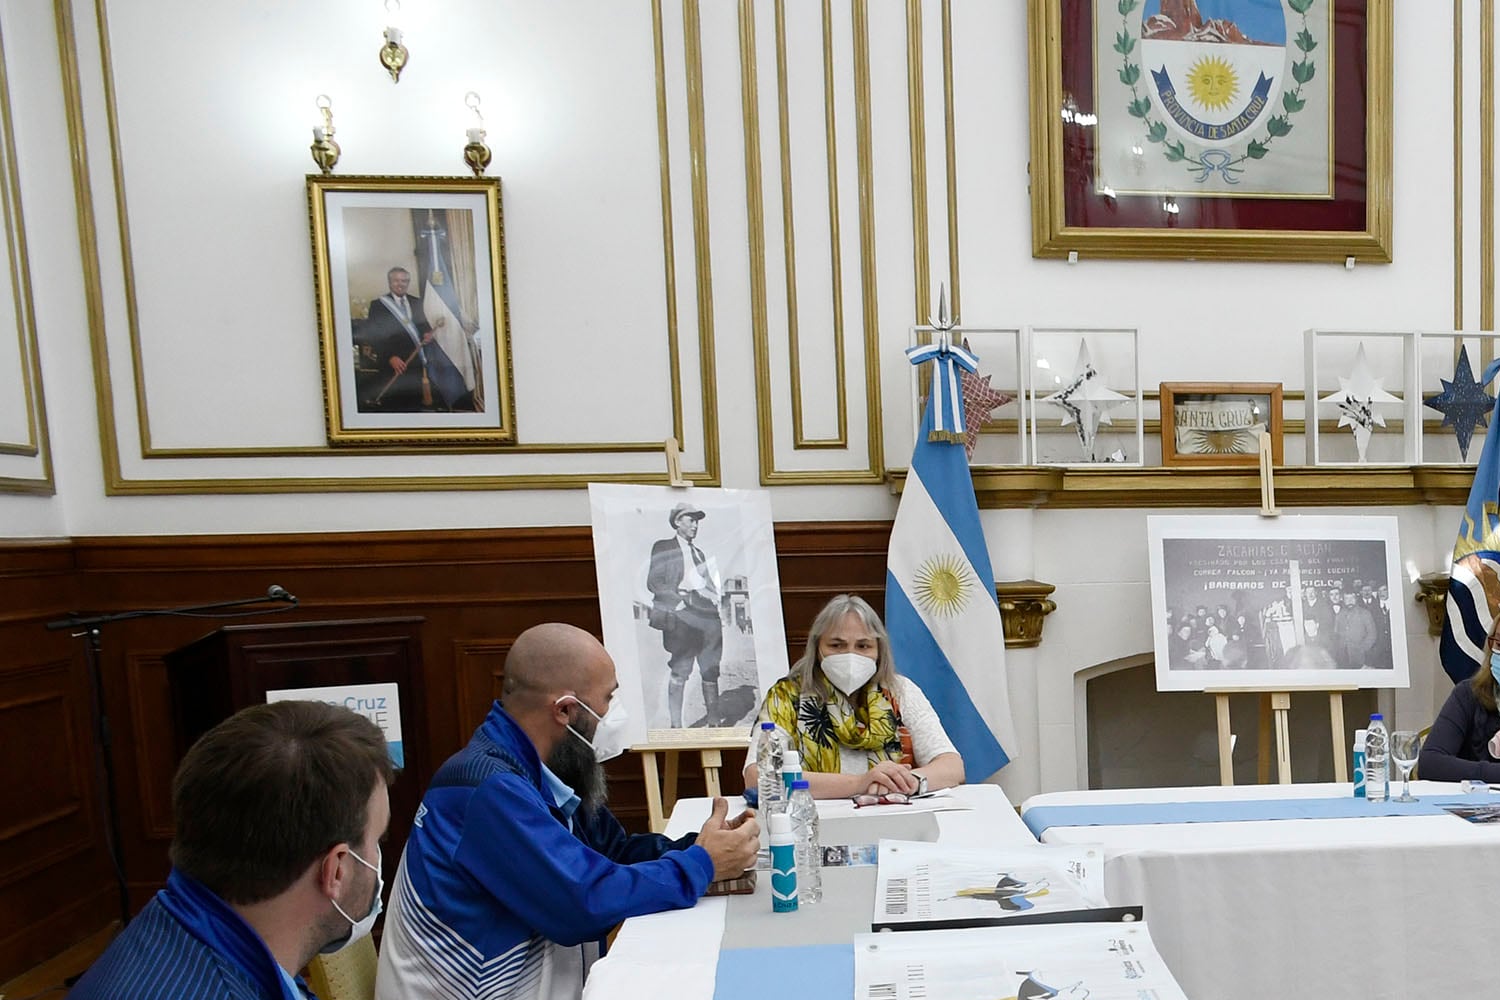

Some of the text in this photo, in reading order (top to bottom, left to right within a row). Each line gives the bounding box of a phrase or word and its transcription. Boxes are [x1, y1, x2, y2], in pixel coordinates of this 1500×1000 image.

[1162, 90, 1265, 139] PROVINCIA DE SANTA CRUZ
[1175, 408, 1252, 428] SANTA CRUZ
[1217, 544, 1275, 558] ZACARIAS
[1226, 568, 1256, 577] FALCON
[1203, 580, 1265, 591] ¡BARBAROS
[343, 696, 387, 711] Cruz
